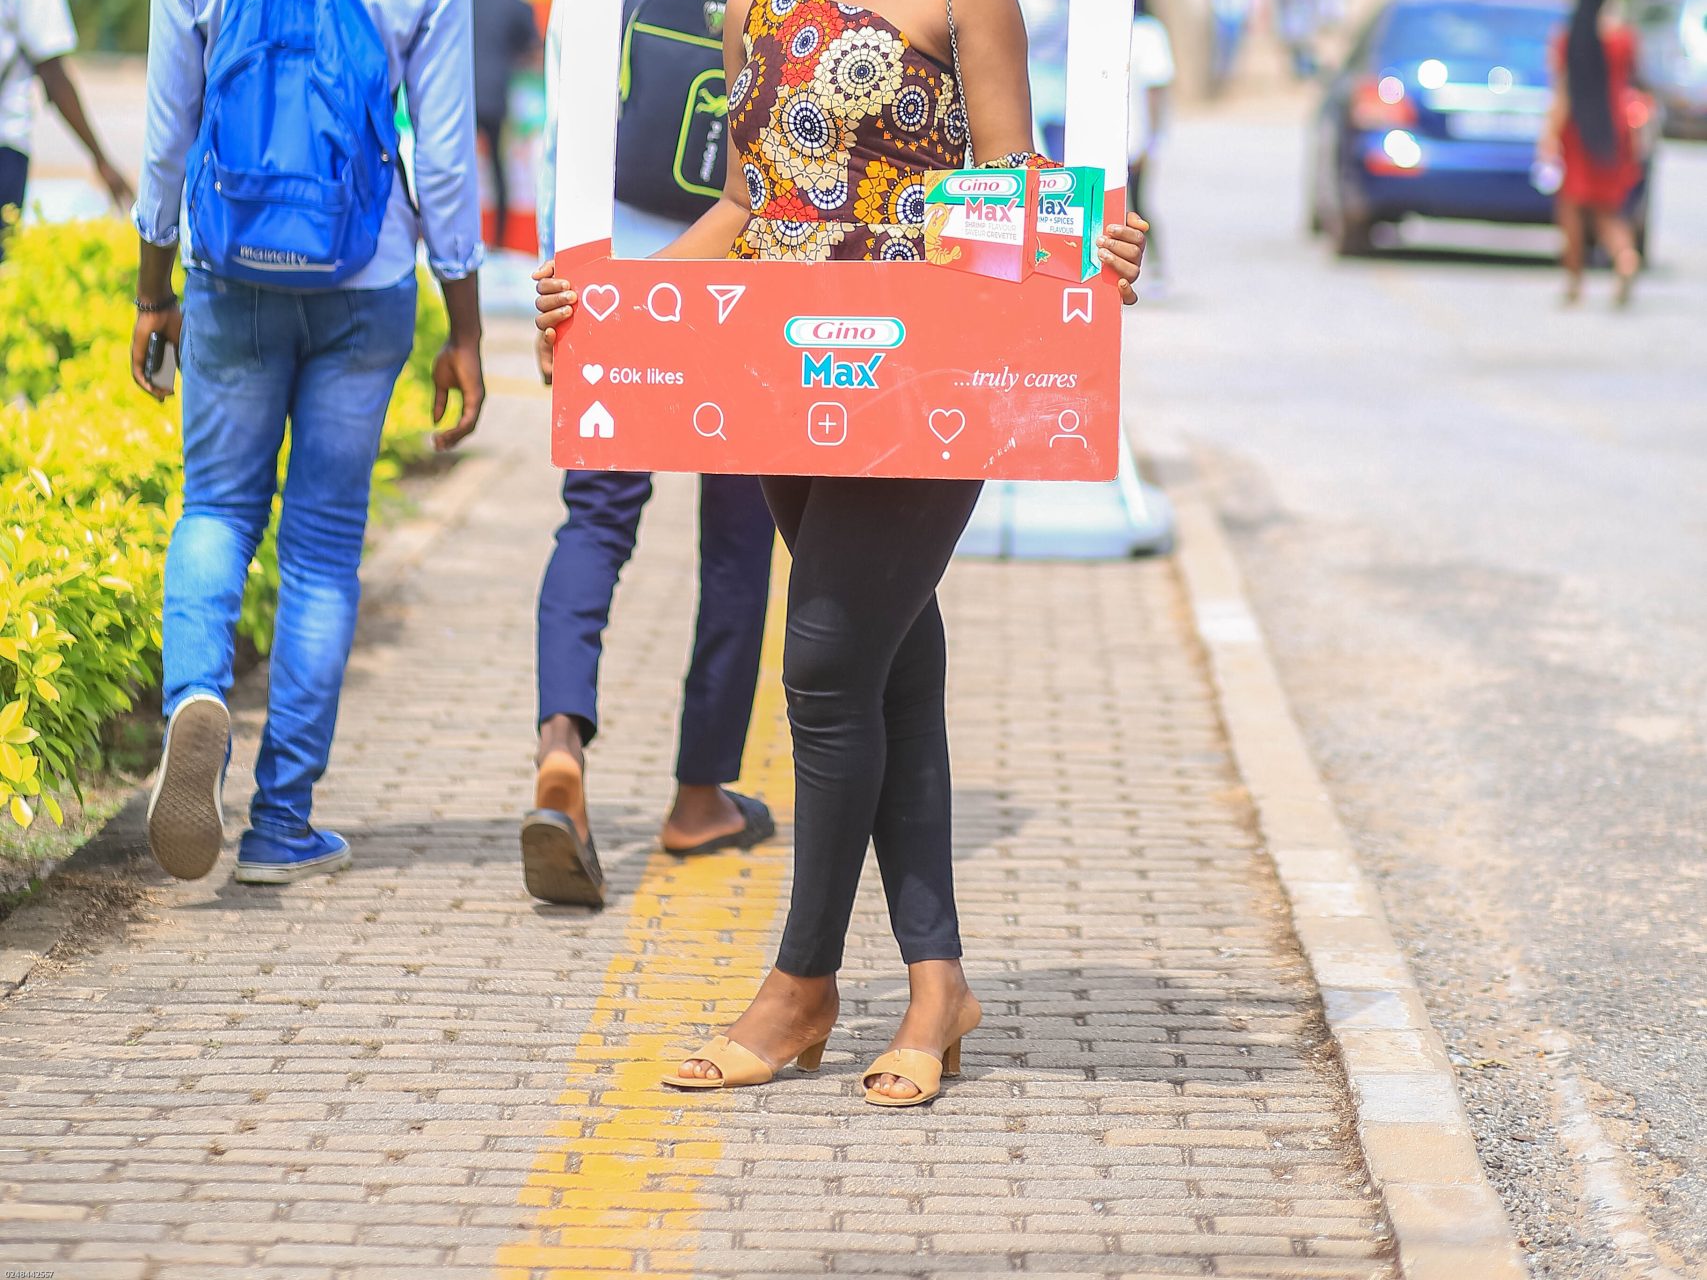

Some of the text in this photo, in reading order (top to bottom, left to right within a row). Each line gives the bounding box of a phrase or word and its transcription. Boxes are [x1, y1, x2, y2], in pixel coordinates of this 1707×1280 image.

[958, 178, 1000, 192] Gino
[1038, 179, 1057, 189] no
[965, 197, 1020, 223] Max
[988, 223, 1017, 232] FLAVOUR
[1038, 216, 1049, 224] IMP
[1053, 217, 1075, 225] SPICES
[987, 230, 1017, 241] CREVETTE
[1050, 226, 1074, 234] FLAVOUR
[812, 321, 876, 340] Gino
[609, 367, 684, 385] 60k likes
[802, 352, 884, 389] Max
[1023, 370, 1077, 388] cares
